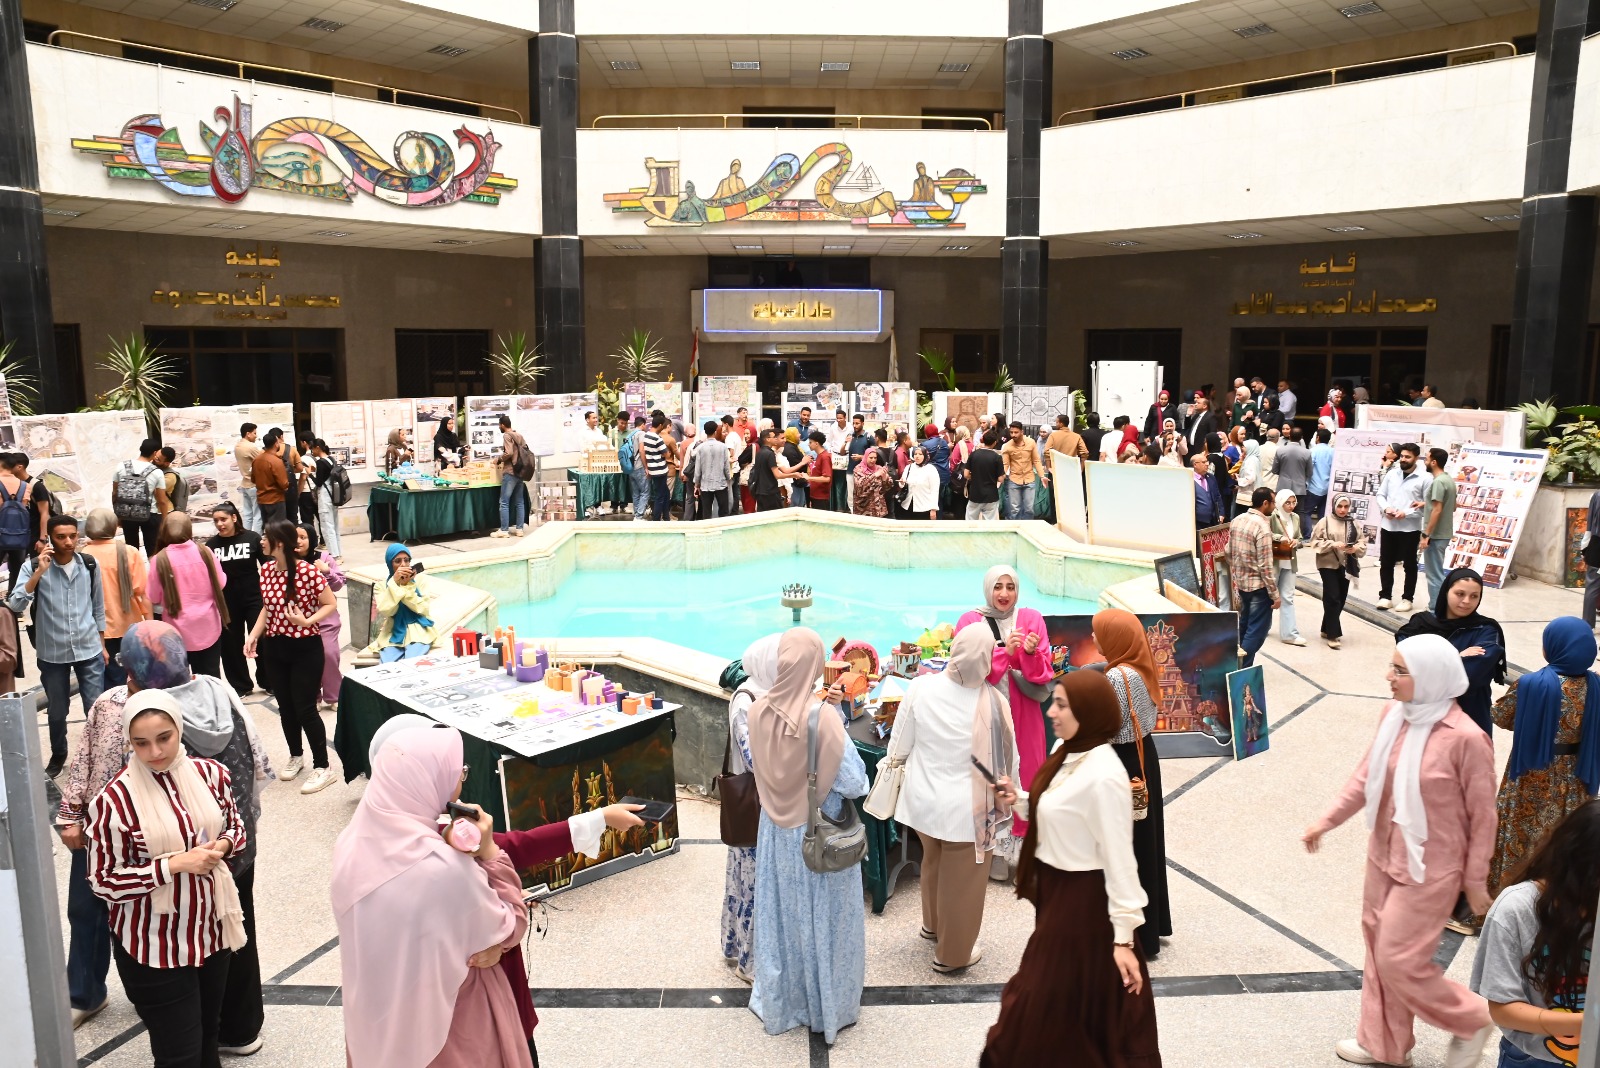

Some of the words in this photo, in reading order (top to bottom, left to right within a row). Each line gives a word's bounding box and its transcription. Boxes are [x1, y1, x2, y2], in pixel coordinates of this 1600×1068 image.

[1299, 252, 1356, 274] قاعة
[753, 301, 805, 323] الضيافة
[809, 301, 832, 318] دار
[214, 542, 251, 562] BLAZE
